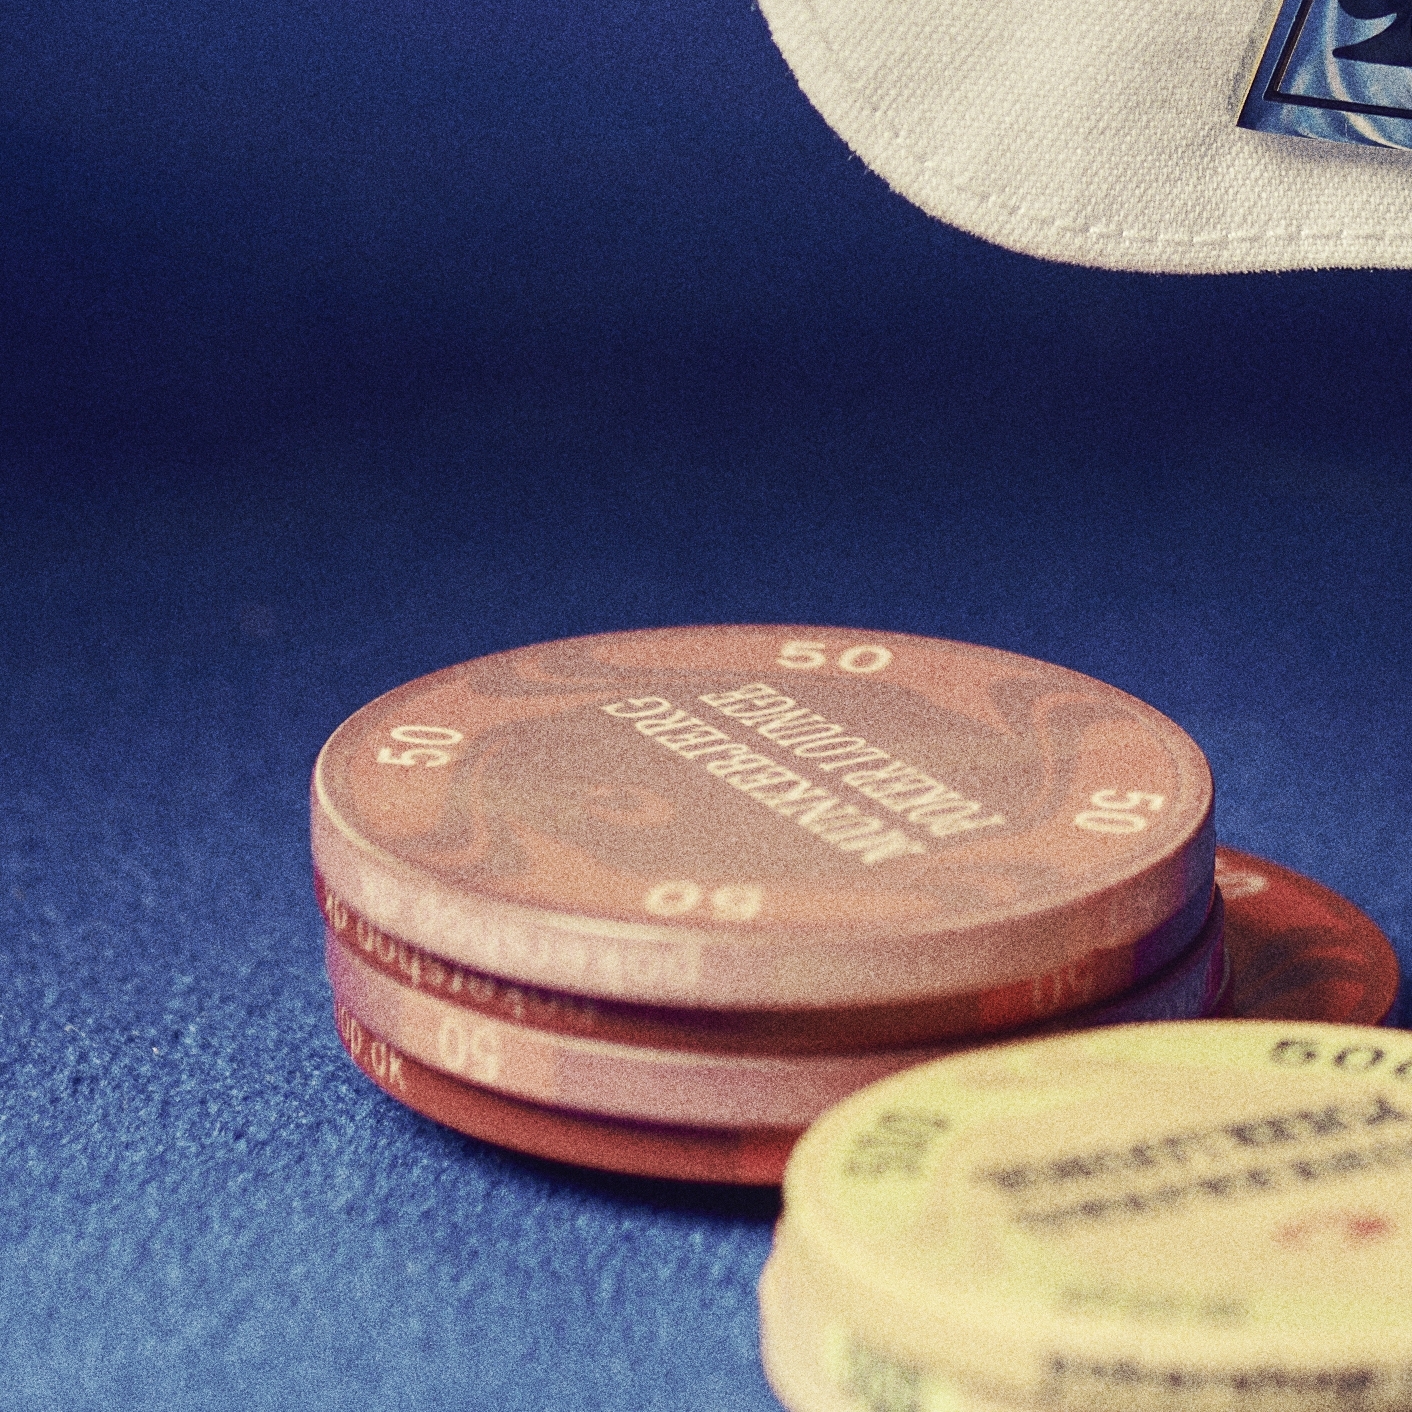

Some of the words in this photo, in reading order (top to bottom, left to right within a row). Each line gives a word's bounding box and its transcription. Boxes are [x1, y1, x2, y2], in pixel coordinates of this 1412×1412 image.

[776, 640, 892, 674] 50
[376, 723, 463, 768] 50
[1073, 787, 1168, 834] 50
[645, 880, 762, 921] 50
[438, 1017, 498, 1081] 50
